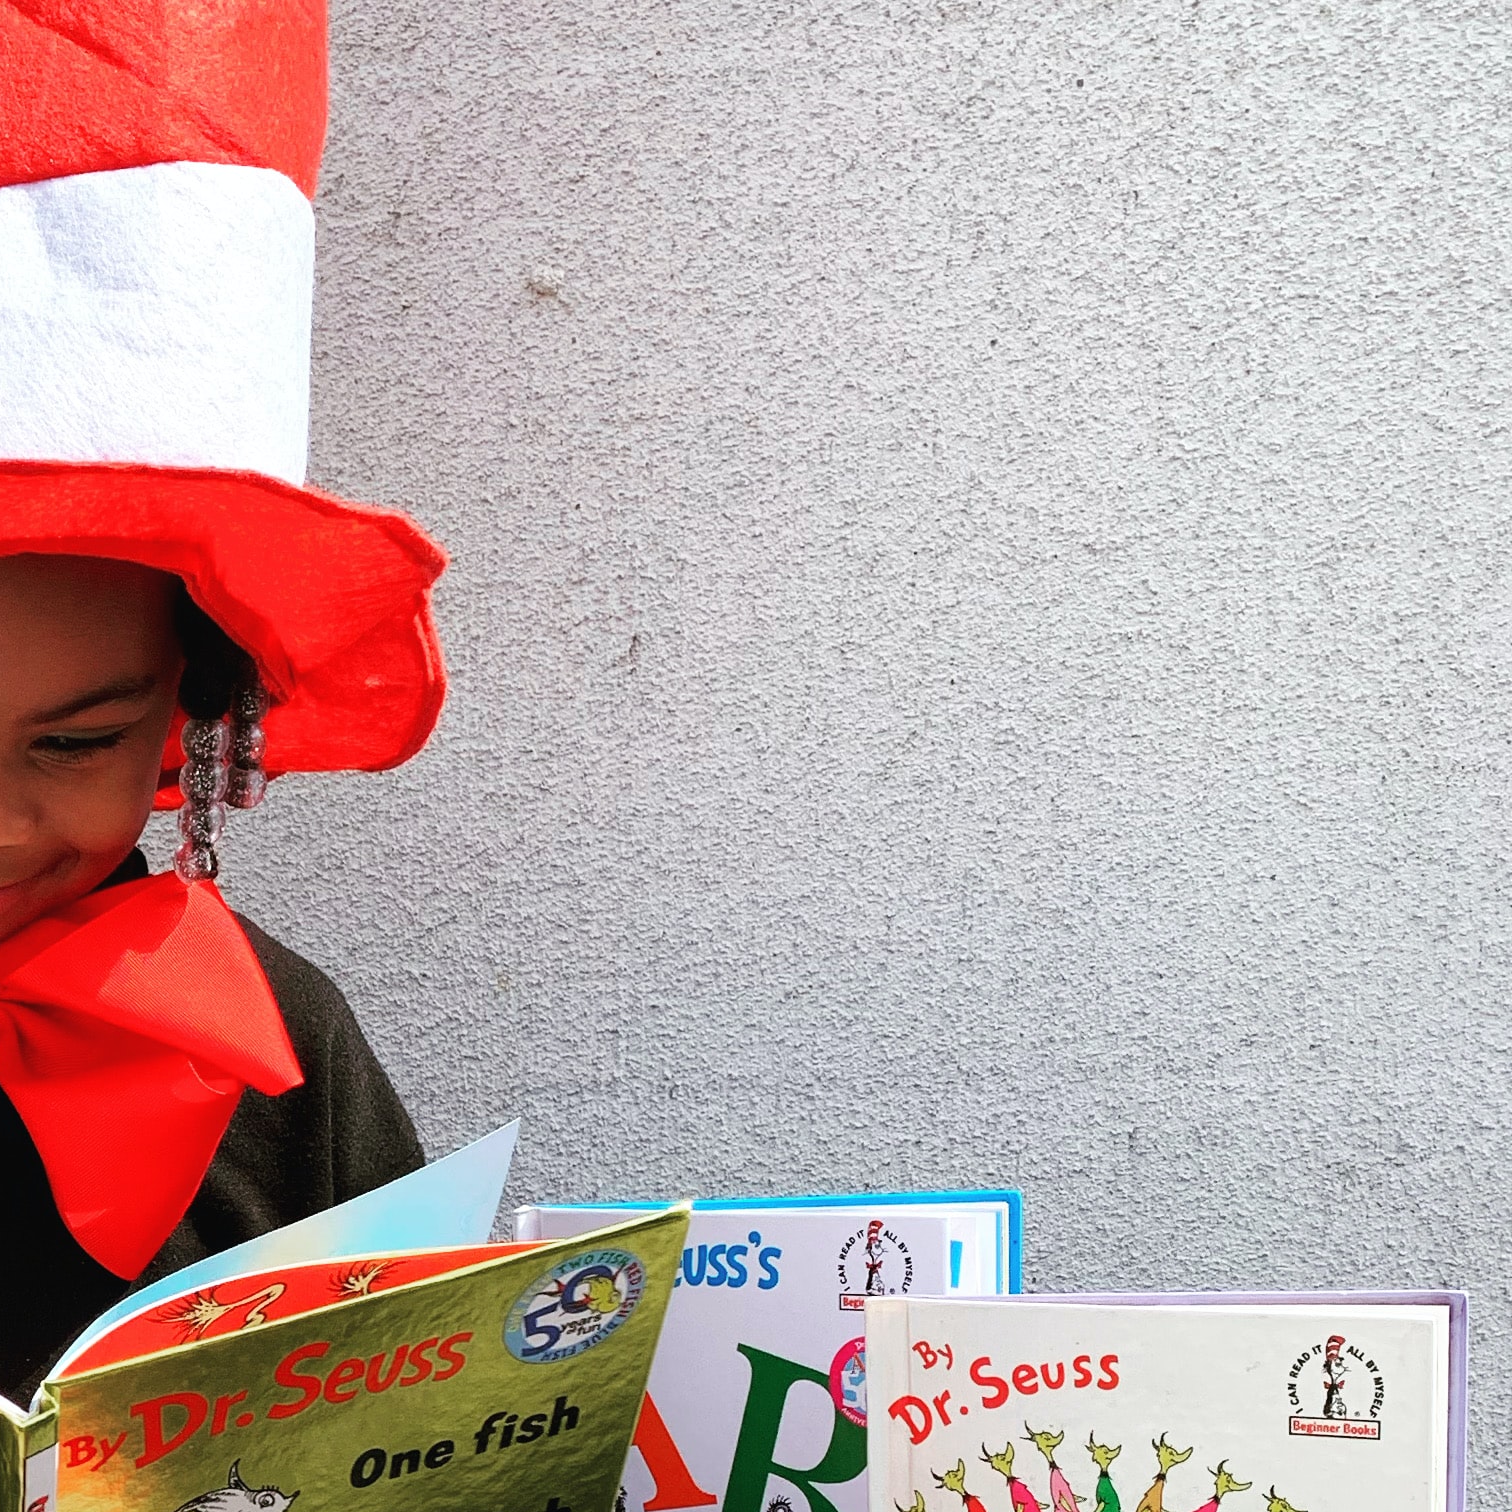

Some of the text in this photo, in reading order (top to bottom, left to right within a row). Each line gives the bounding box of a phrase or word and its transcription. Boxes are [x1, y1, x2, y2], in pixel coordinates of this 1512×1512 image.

[856, 1229, 865, 1239] IT
[883, 1229, 899, 1244] ALL
[838, 1236, 856, 1261] READ
[897, 1242, 909, 1254] BY
[557, 1254, 595, 1275] TWO
[598, 1252, 632, 1267] FISH
[837, 1264, 848, 1285] CAN
[901, 1256, 914, 1294] MYSELF
[911, 1340, 954, 1371] By
[1287, 1344, 1385, 1419] I CAN READ IT ALL BY MYSELF
[62, 1330, 475, 1472] By Dr. Seuss
[887, 1354, 1120, 1446] Dr. Seuss
[1292, 1420, 1377, 1436] Beginner Books
[348, 1394, 582, 1489] One fish
